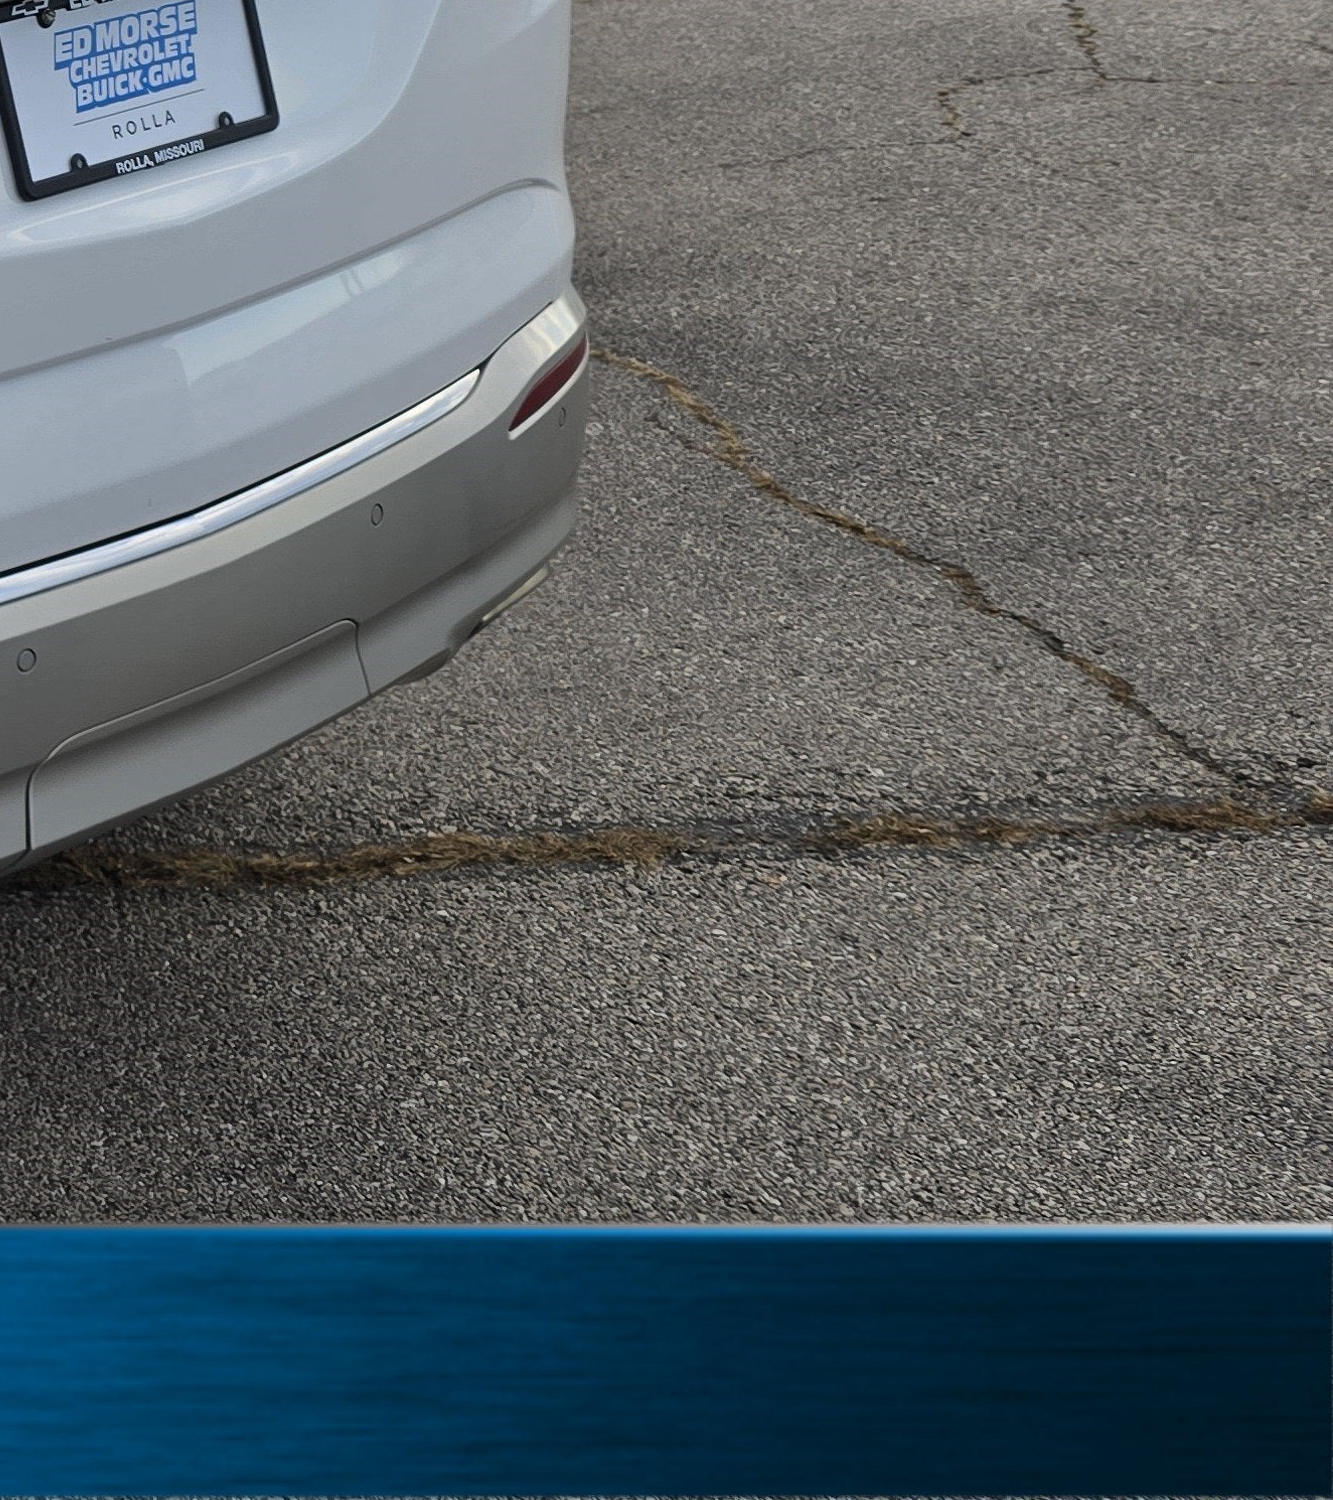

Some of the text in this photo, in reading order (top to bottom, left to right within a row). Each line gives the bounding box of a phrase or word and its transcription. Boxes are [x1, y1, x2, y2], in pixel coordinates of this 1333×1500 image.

[54, 1, 197, 66] ED MORSE
[68, 34, 193, 84] CHEVROLET
[111, 110, 176, 140] ROLLA
[115, 138, 205, 175] ROLLA, MISSOURI
